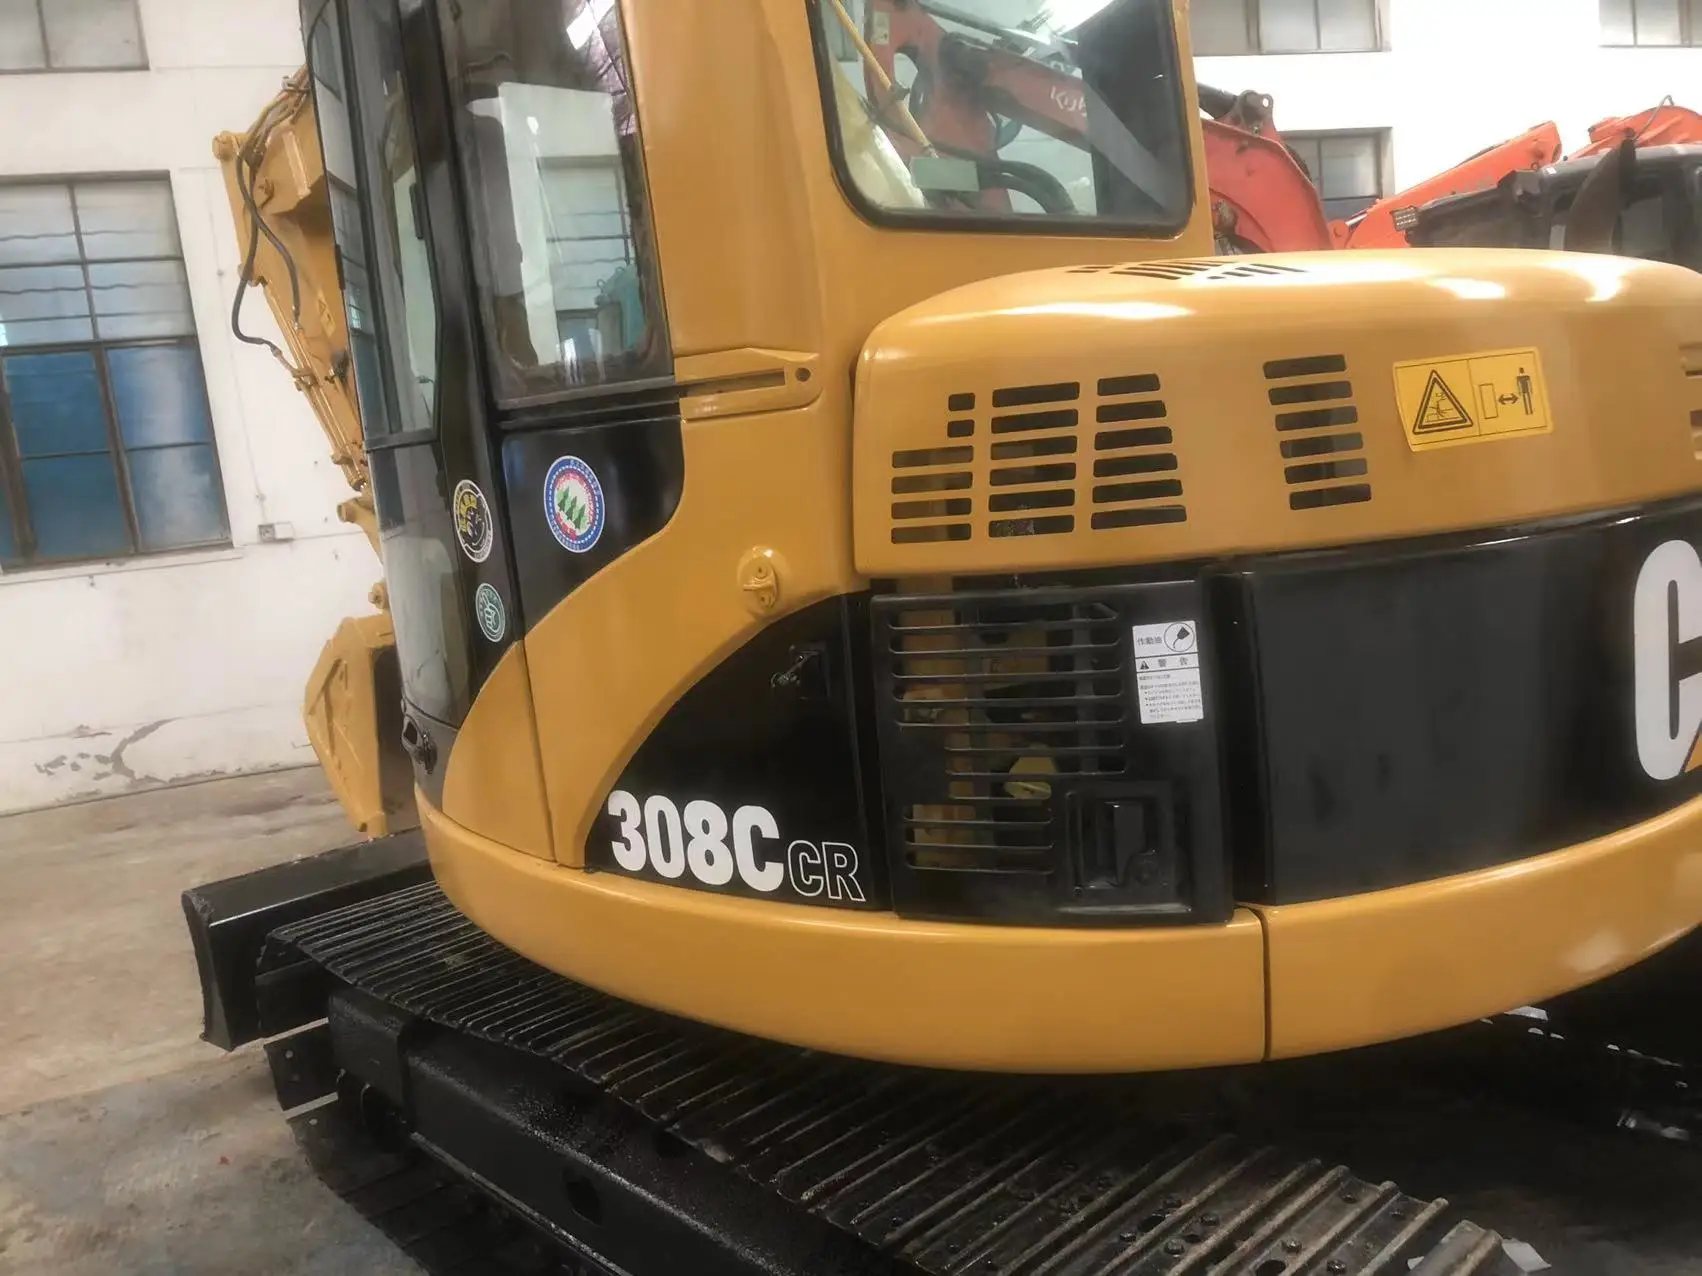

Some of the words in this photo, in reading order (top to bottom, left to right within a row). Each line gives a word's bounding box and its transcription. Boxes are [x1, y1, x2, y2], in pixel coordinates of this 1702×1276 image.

[1634, 540, 1702, 780] C
[608, 790, 784, 892] 308C
[788, 840, 866, 902] CR
